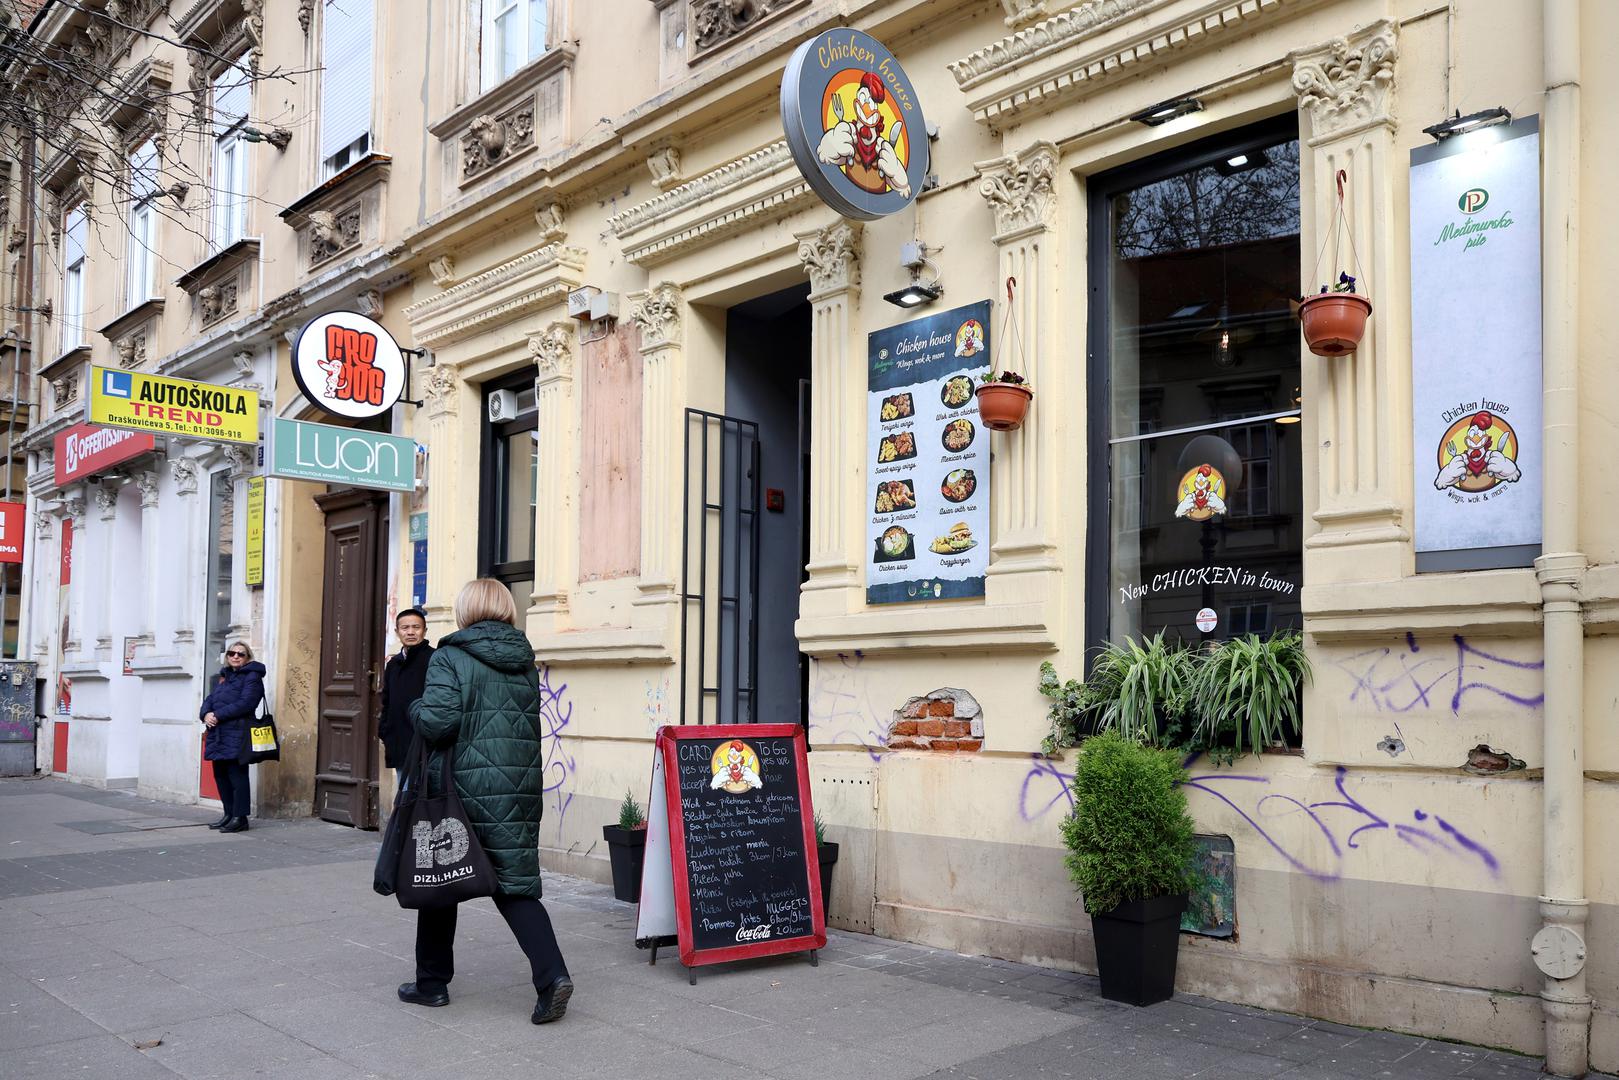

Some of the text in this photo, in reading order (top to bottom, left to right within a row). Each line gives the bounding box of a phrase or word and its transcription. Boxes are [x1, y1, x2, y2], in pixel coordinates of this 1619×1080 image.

[819, 35, 913, 111] Chicken house
[1463, 233, 1487, 252] pile
[896, 331, 952, 355] Chicken house
[140, 381, 247, 415] AUTOŠKOLA
[129, 402, 223, 426] TREND
[1441, 397, 1509, 423] Chicken house
[108, 414, 163, 429] Draškovićeva
[175, 423, 191, 432] Tel.:
[193, 425, 242, 438] 01/3096-918
[79, 428, 134, 460] OFFERTISSI
[1491, 485, 1508, 497] more
[1120, 566, 1295, 604] New CHICKEN in town
[680, 744, 712, 761] CARD
[756, 740, 787, 756] To Go
[761, 756, 775, 772] yes
[683, 799, 700, 809] Wok
[690, 844, 740, 858] Ludburger
[724, 869, 743, 884] juha
[766, 897, 808, 914] NUGGETS
[702, 917, 735, 931] Pommes
